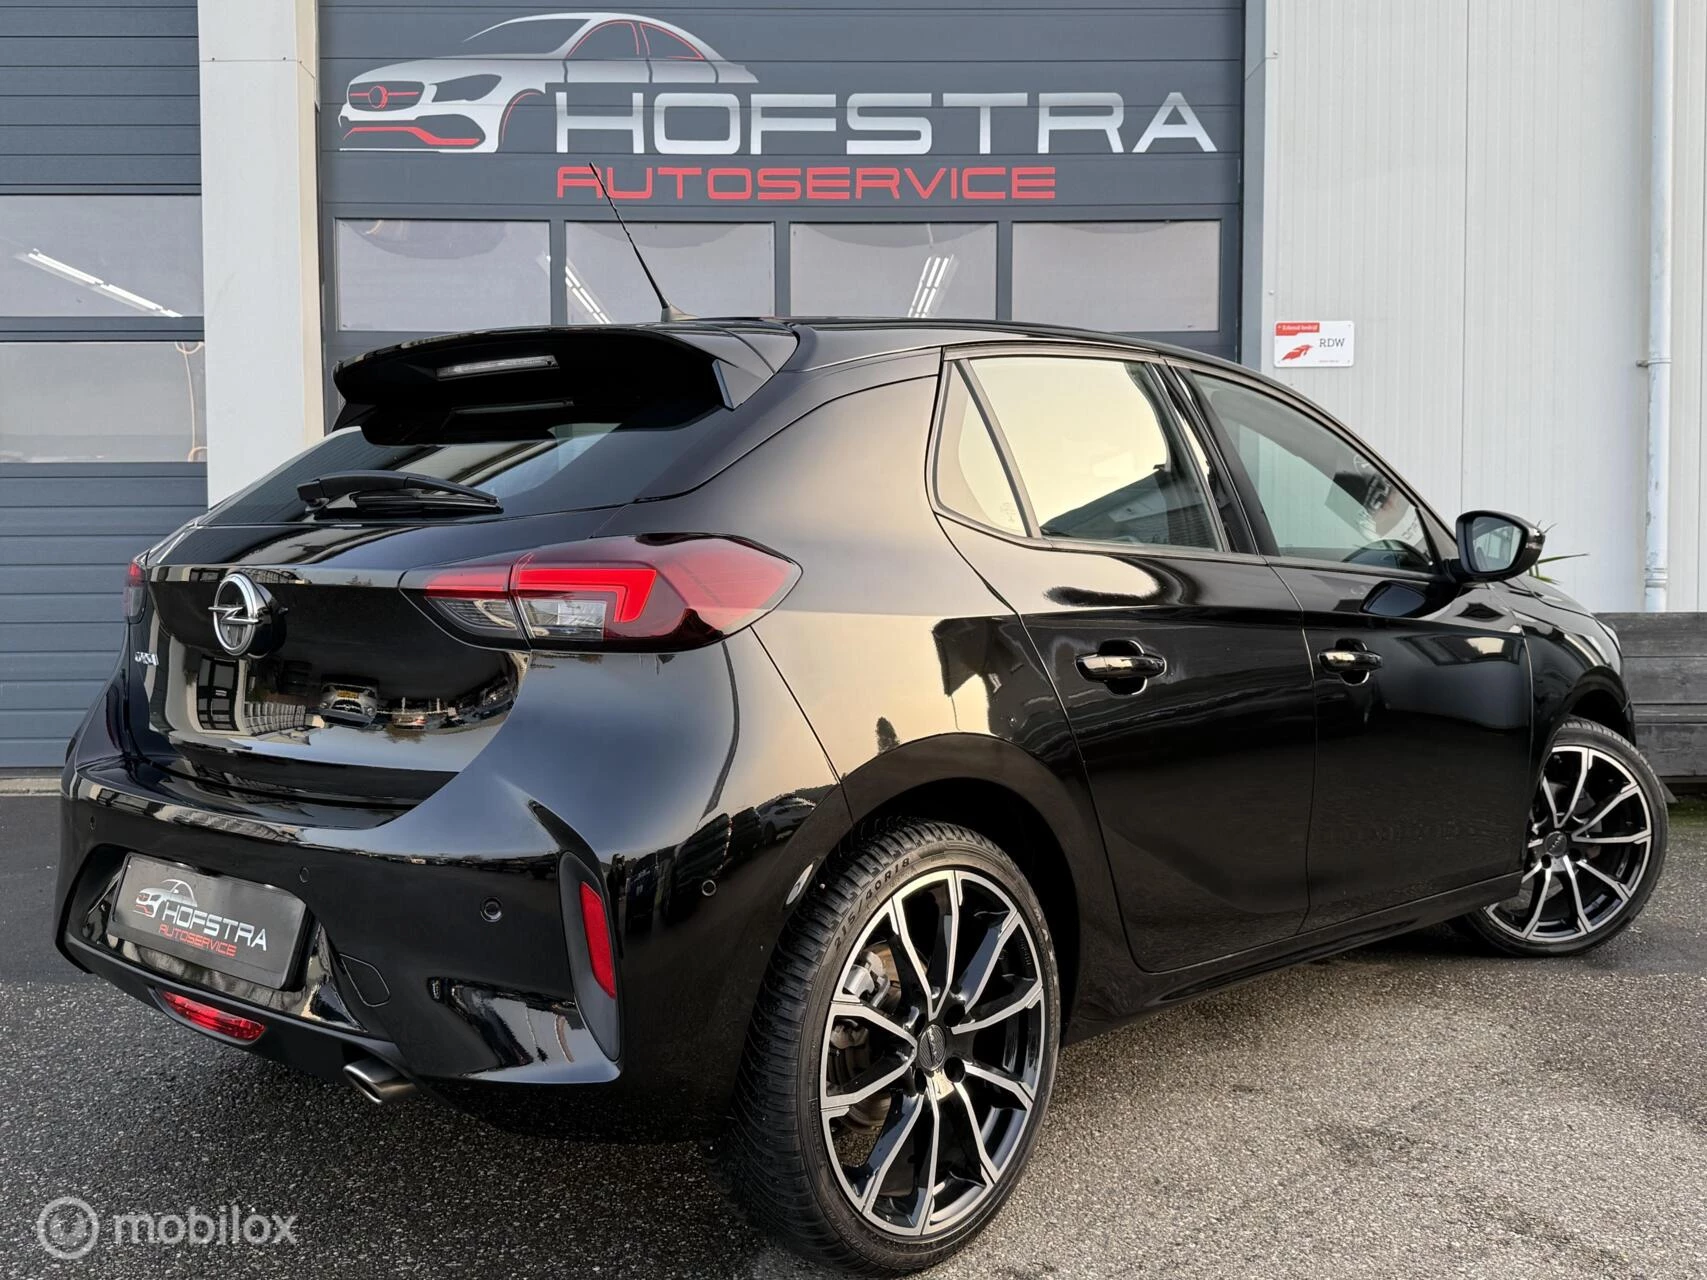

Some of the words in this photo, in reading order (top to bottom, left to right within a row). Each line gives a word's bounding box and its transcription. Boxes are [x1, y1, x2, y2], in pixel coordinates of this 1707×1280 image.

[556, 91, 1217, 154] HOFSTRA
[557, 167, 1056, 200] AUTOSERVICE
[1319, 338, 1345, 347] RDW
[159, 924, 237, 957] AUTOSERVICE
[162, 902, 267, 951] HOFSTRA
